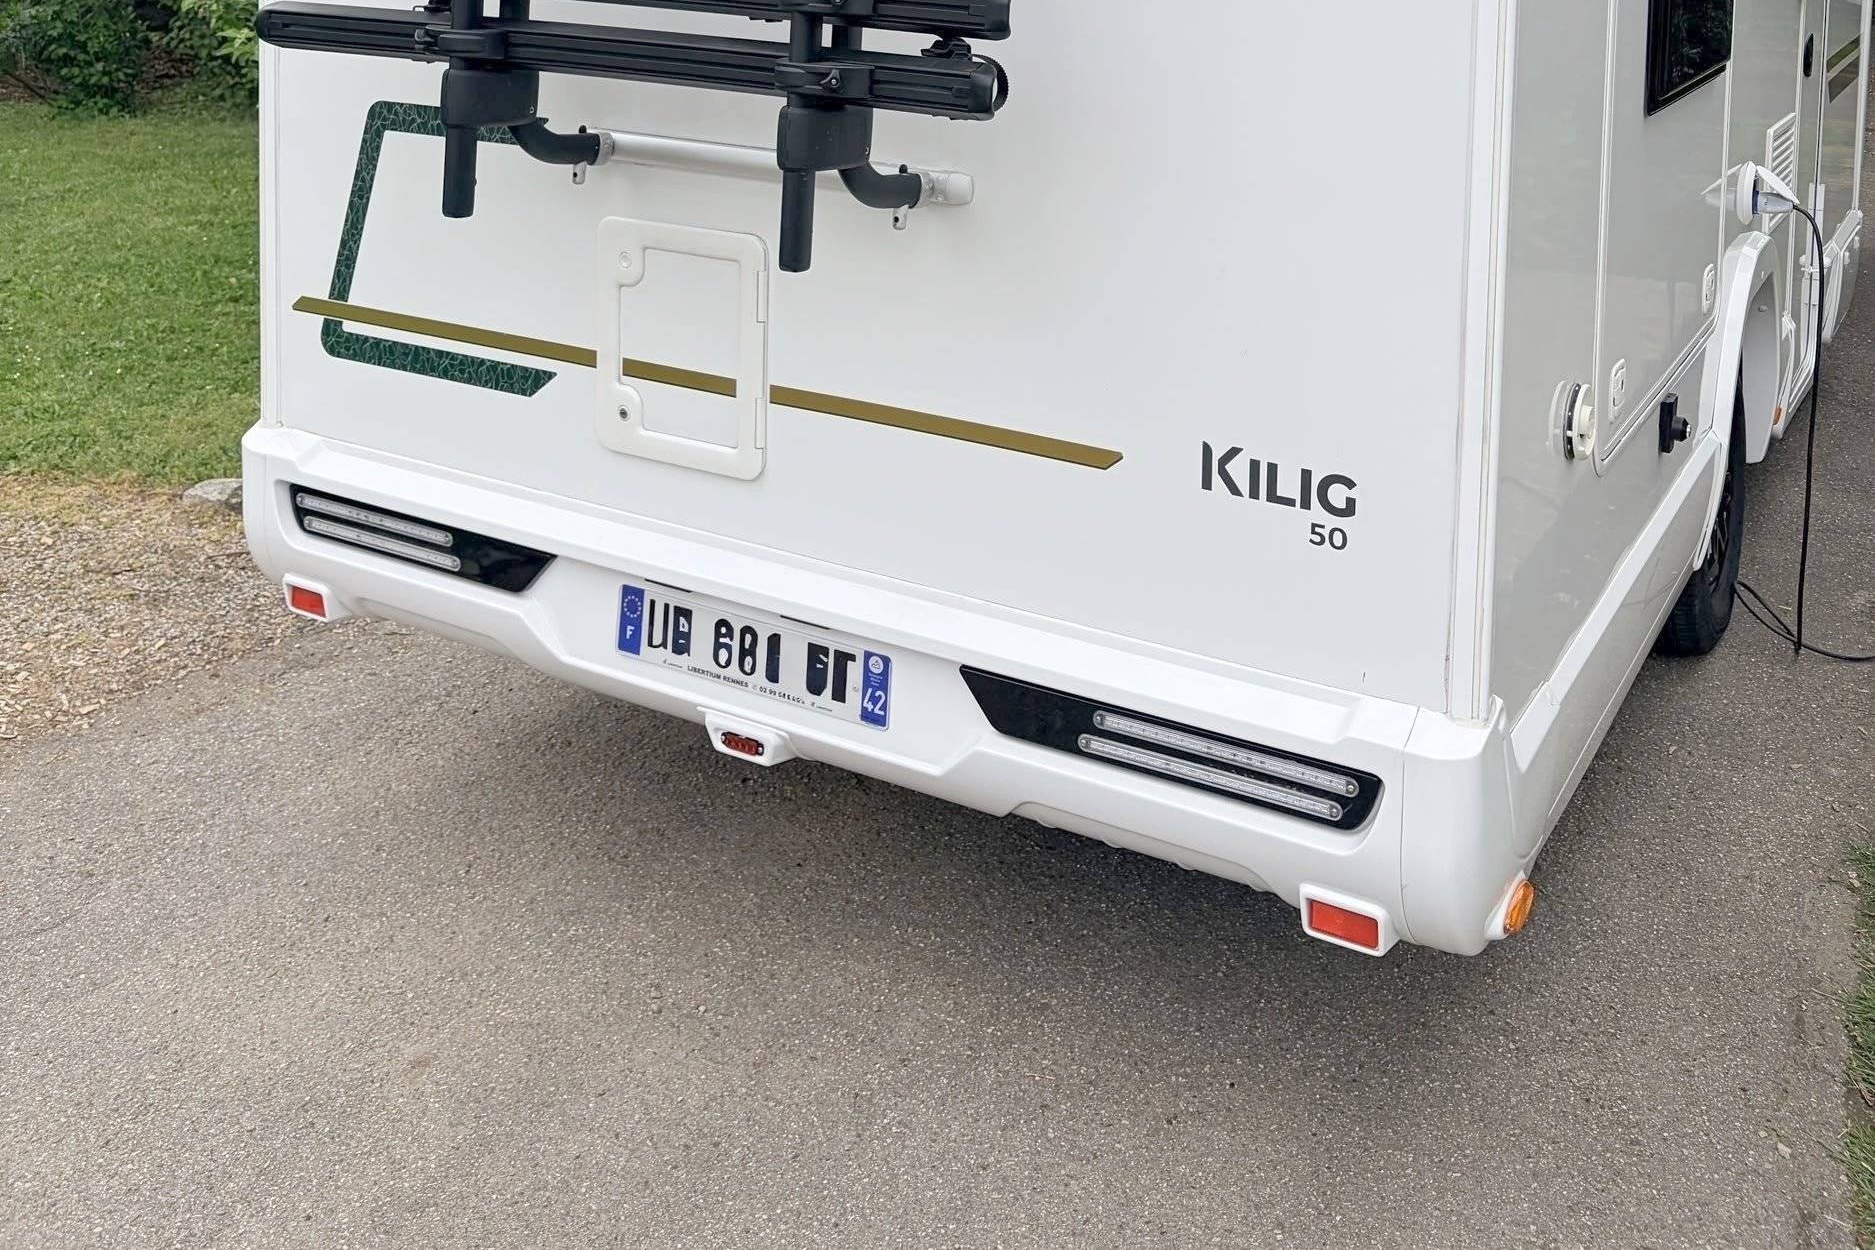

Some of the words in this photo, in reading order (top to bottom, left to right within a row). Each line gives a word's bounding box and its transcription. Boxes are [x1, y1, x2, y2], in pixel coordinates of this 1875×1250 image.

[1201, 440, 1357, 518] KILIG
[1308, 522, 1348, 551] 50
[626, 625, 635, 639] F
[687, 665, 721, 681] LIBERTIUM
[722, 675, 749, 688] RENNES
[863, 687, 885, 717] 42
